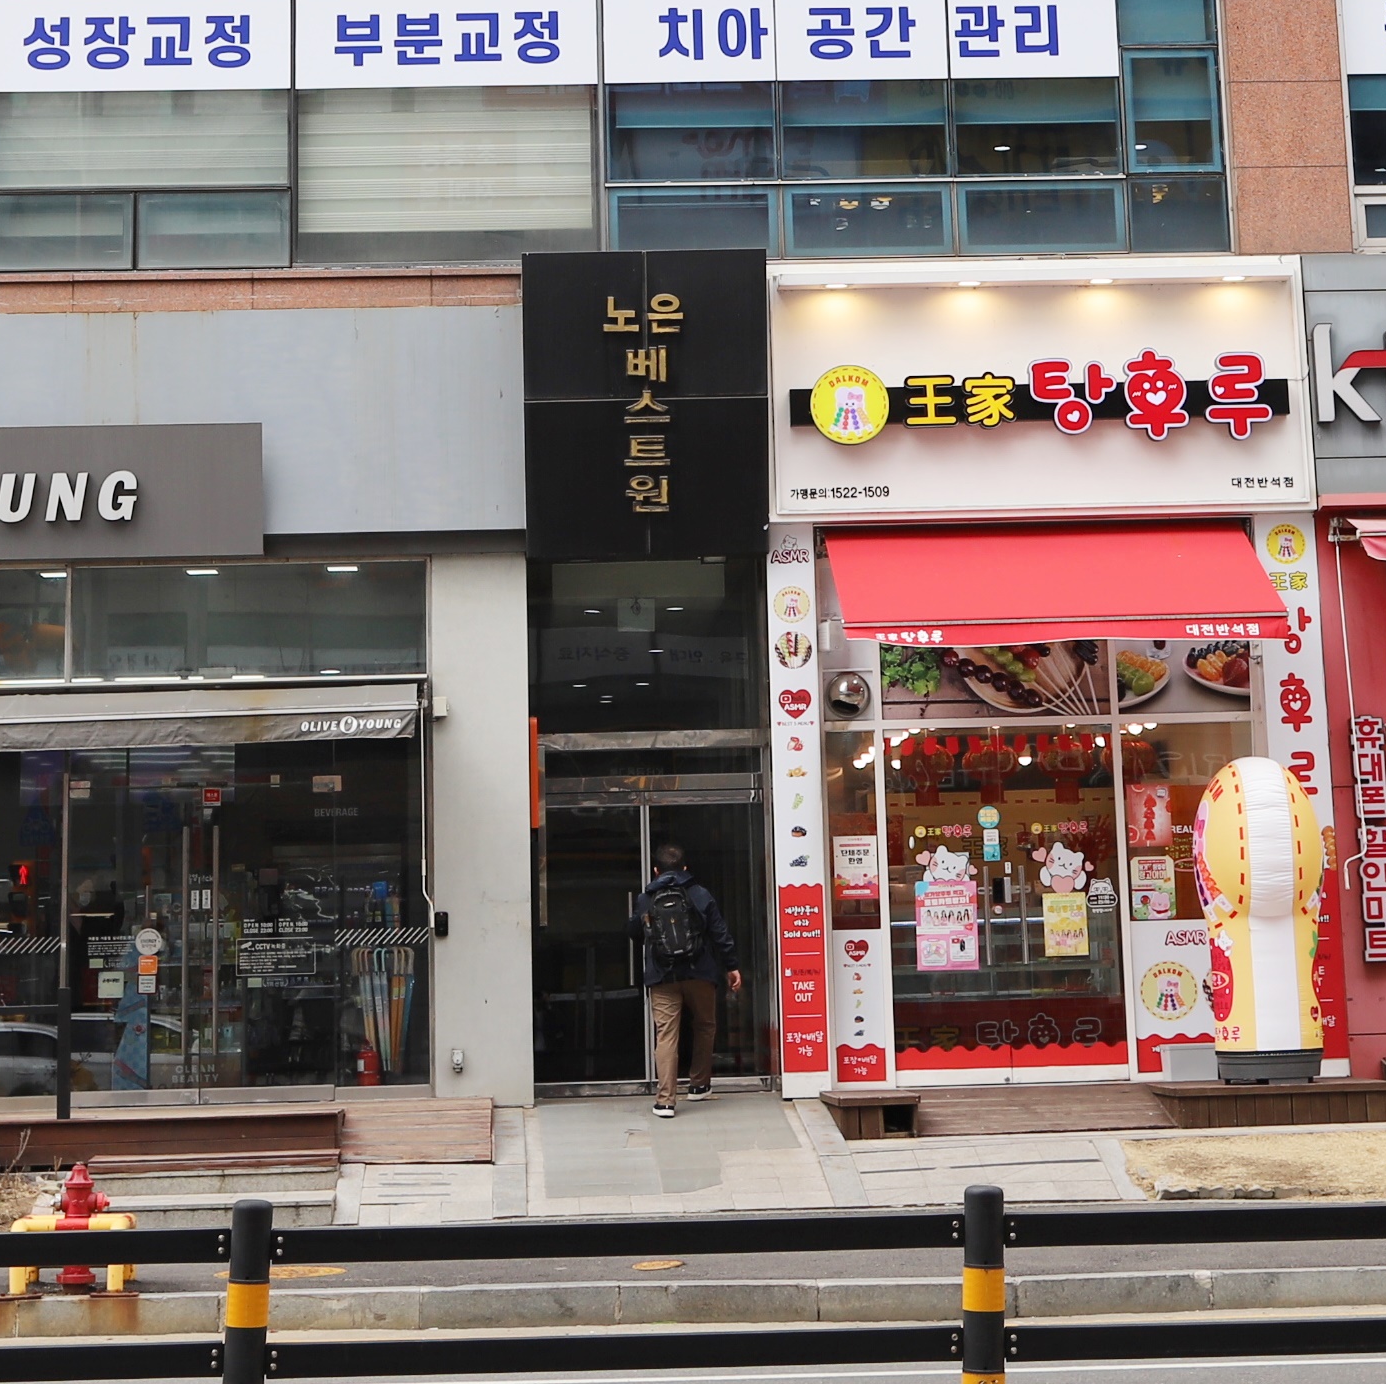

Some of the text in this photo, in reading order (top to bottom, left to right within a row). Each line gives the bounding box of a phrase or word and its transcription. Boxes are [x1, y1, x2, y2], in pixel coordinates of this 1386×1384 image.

[332, 6, 564, 68] 부분교정
[656, 1, 1062, 62] 치아 공간 관리
[22, 13, 255, 72] 성장교정
[603, 293, 684, 334] 노은
[827, 375, 871, 390] DALKOM
[905, 347, 1274, 442] 王家 탕후루
[623, 345, 671, 513] 베스트원
[1230, 475, 1296, 489] 대전반석점
[771, 548, 810, 564] ASMR
[1186, 622, 1261, 637] 대전반석점
[784, 703, 808, 711] ASMR
[300, 718, 403, 732] OLIVE YOUNG
[314, 807, 359, 818] BEVERAGE
[783, 929, 801, 938] Sold
[1164, 929, 1207, 946] ASMR
[792, 981, 815, 991] TAKE
[794, 992, 813, 1002] OUT
